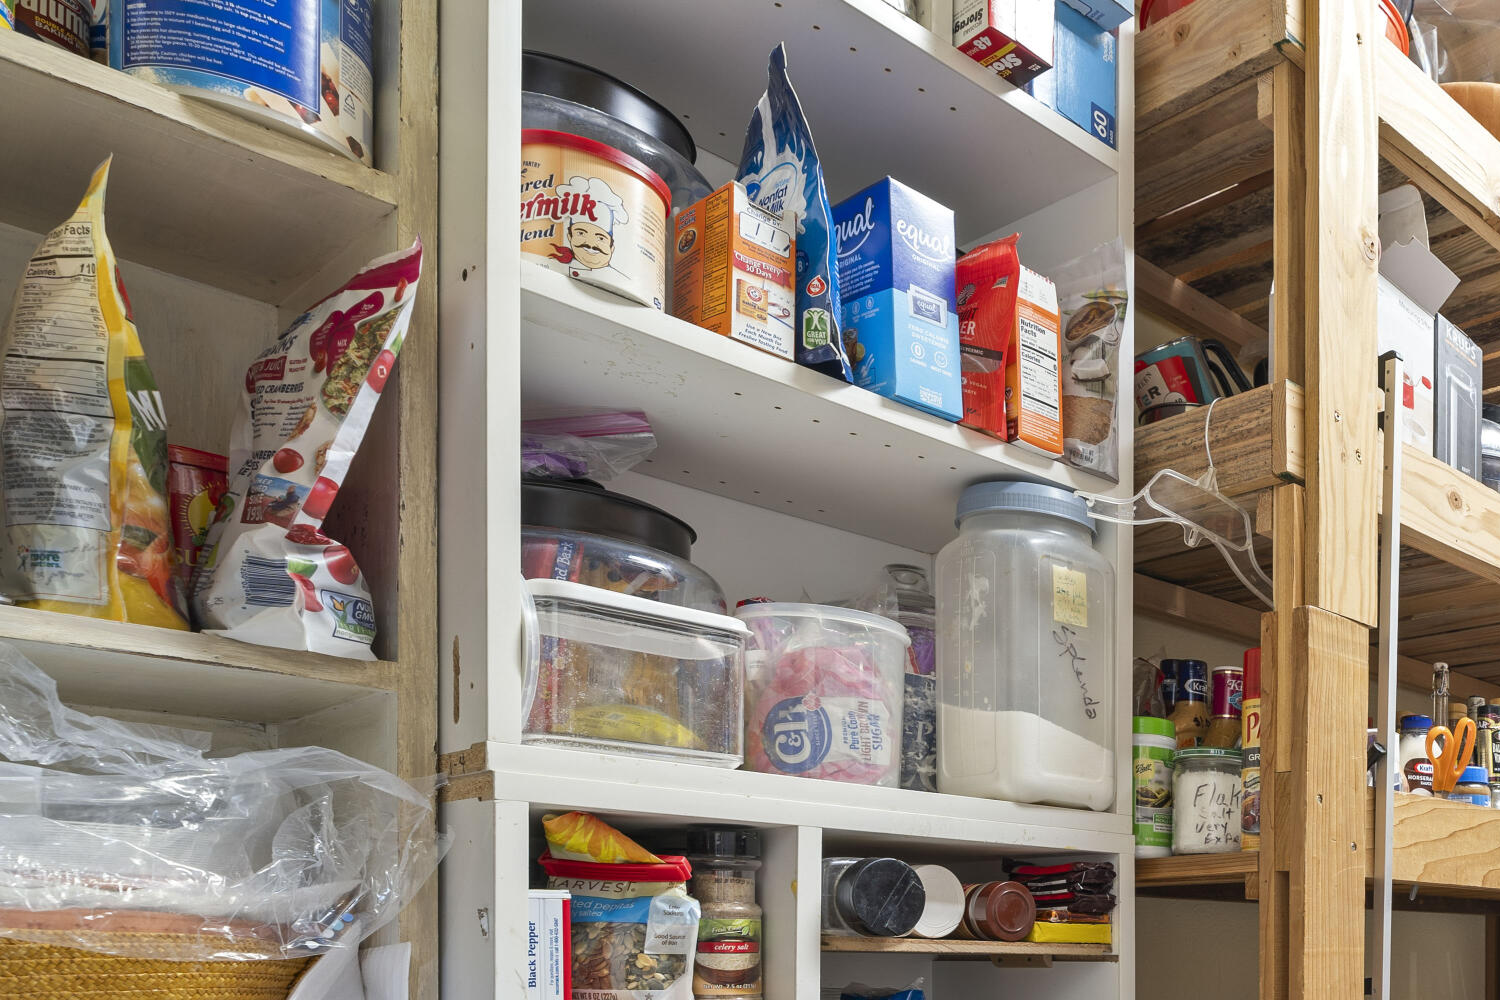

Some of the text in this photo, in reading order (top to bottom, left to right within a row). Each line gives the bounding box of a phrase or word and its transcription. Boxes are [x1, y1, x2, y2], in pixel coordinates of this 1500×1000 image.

[974, 35, 992, 50] 48
[1094, 110, 1107, 138] 60
[759, 185, 788, 207] Nonfat
[63, 225, 91, 236] Facts
[896, 218, 953, 260] equal
[27, 262, 96, 277] Calories 110
[735, 253, 783, 276] Change Every
[912, 254, 941, 272] ORIGINAL
[746, 264, 772, 279] 30 Days
[1020, 327, 1037, 339] Facts
[1021, 318, 1046, 336] Nutrition
[807, 330, 827, 340] GREAT
[1444, 322, 1477, 361] KRUPS
[1021, 351, 1041, 365] Calories
[1135, 763, 1153, 774] Ball
[1195, 822, 1228, 834] Very
[593, 899, 636, 912] pepitas
[527, 921, 539, 988] Black Pepper
[714, 942, 750, 952] celery salt
